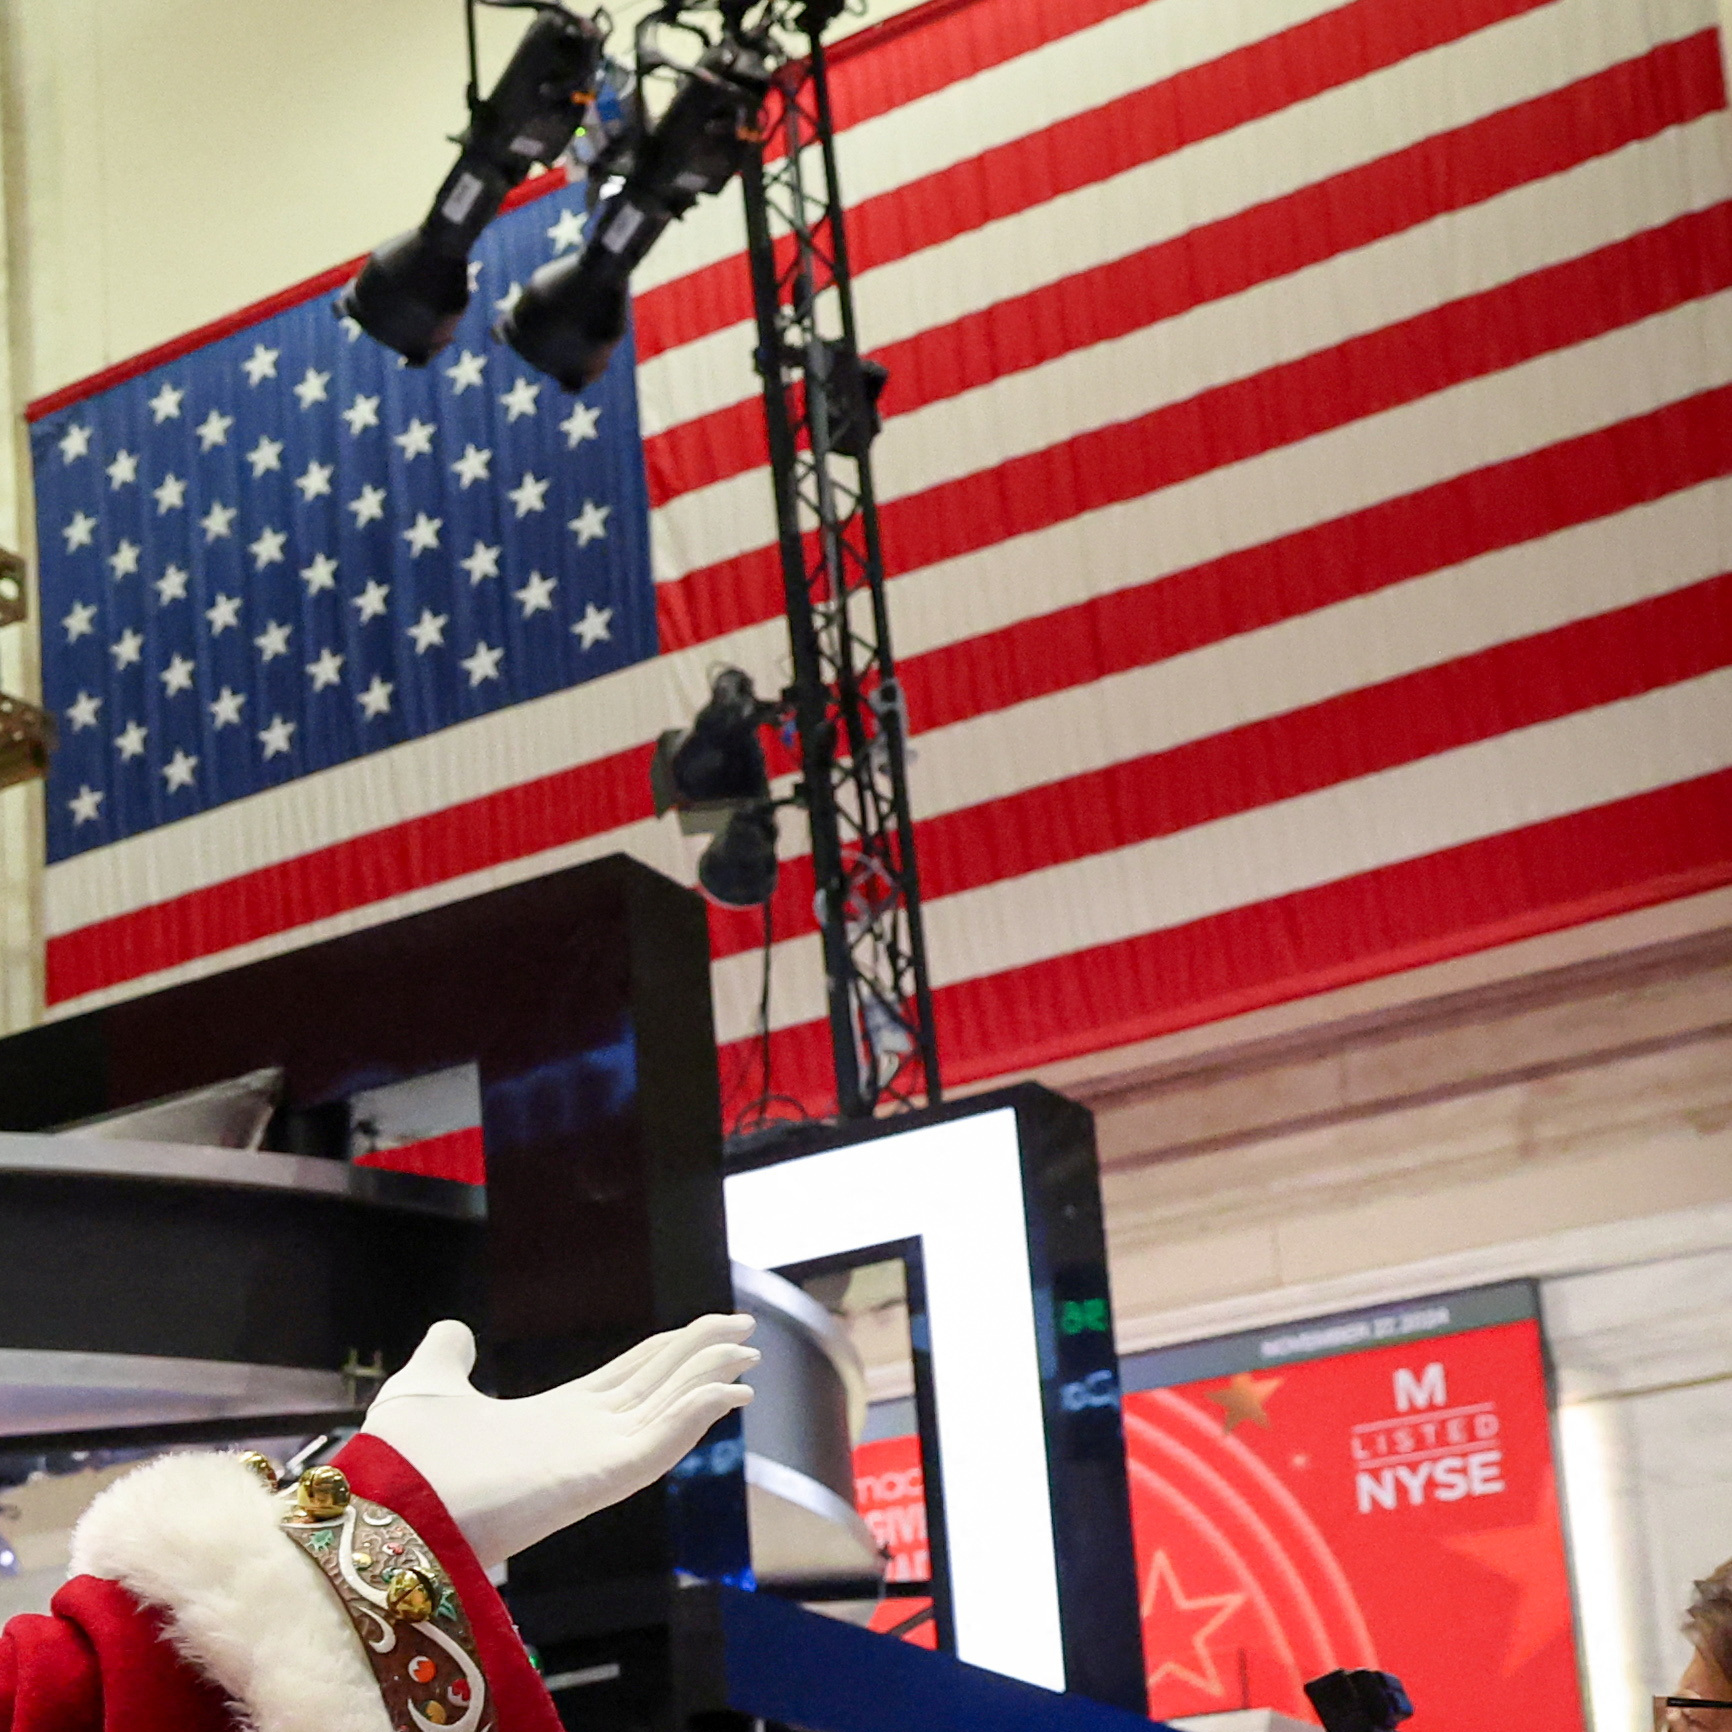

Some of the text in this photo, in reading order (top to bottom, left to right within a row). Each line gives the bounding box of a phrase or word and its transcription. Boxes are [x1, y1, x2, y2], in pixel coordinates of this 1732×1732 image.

[1392, 1361, 1448, 1412] M
[1350, 1413, 1500, 1461] LISTED
[1355, 1449, 1507, 1515] NYSE
